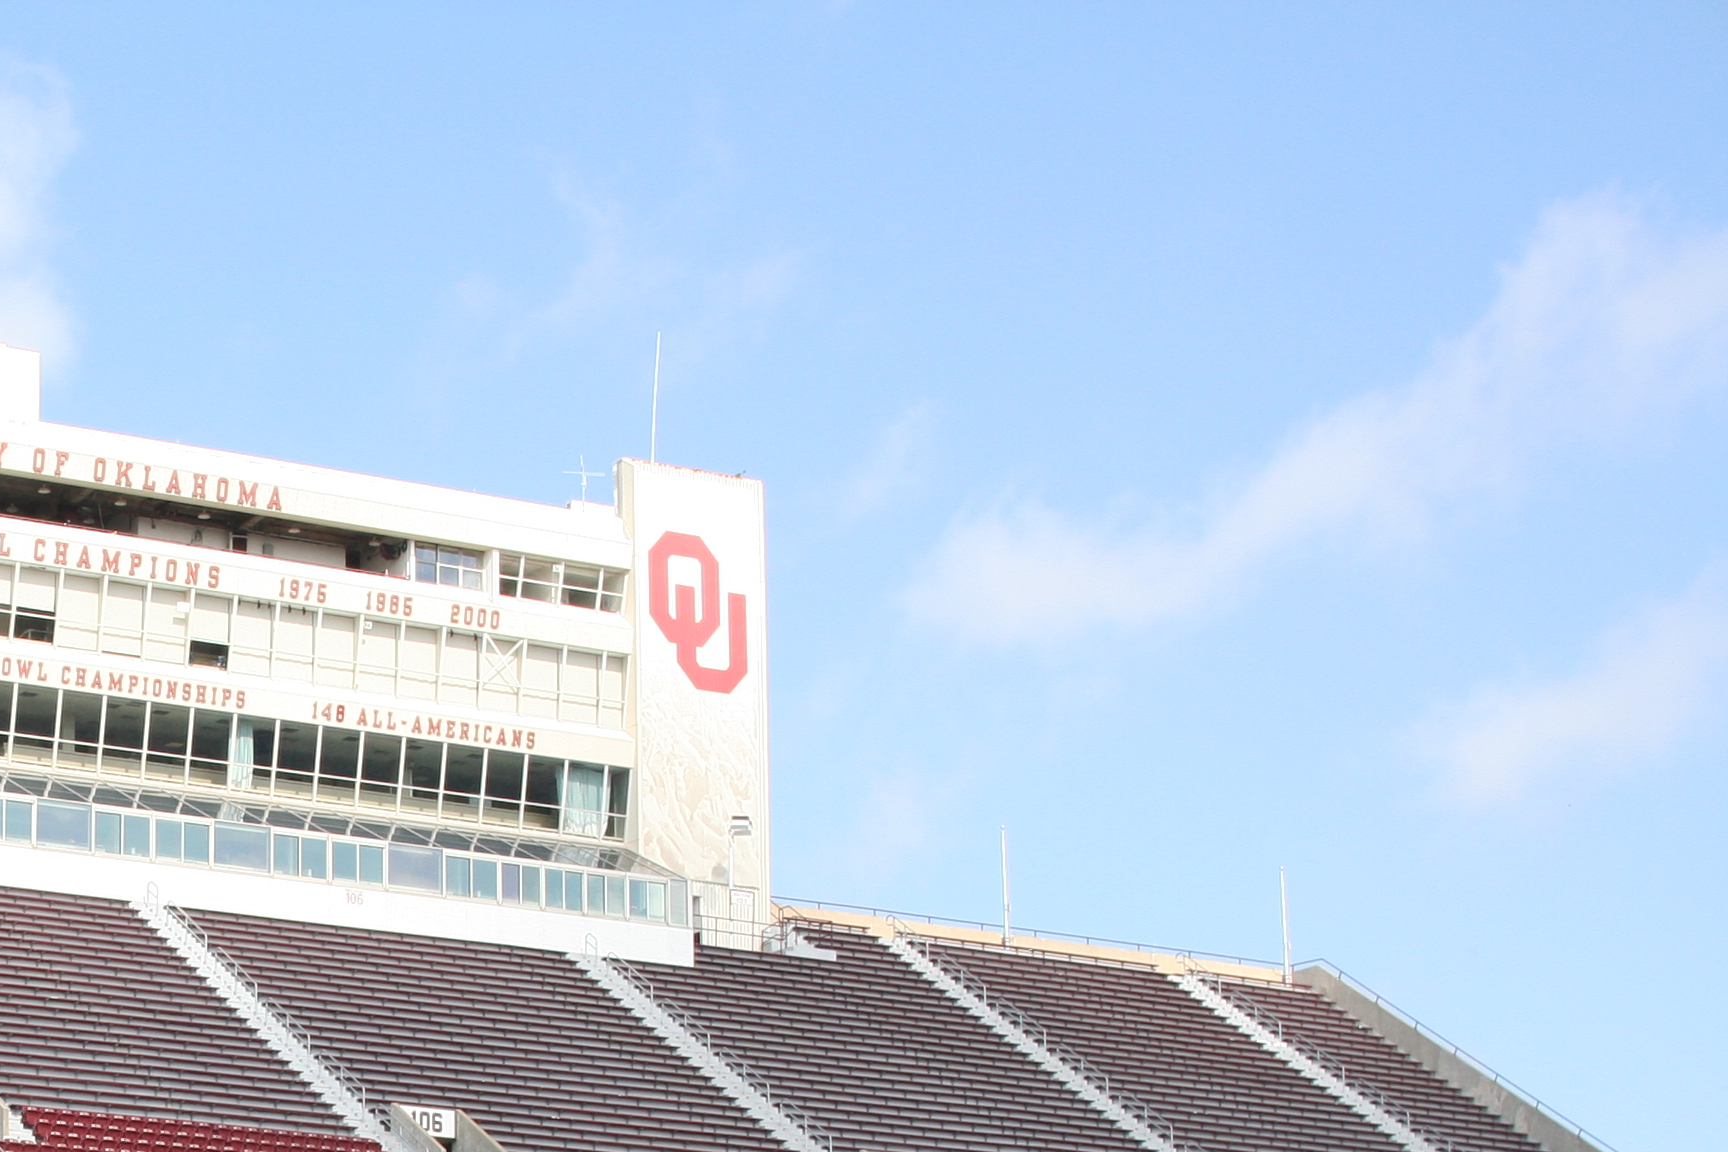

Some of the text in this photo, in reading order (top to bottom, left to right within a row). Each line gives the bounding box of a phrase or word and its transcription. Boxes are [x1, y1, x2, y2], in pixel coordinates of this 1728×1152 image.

[33, 447, 70, 477] OF
[93, 458, 283, 511] OKLAHOMA
[33, 539, 221, 588] CHAMPIONS
[278, 577, 327, 603] 1975
[365, 591, 413, 617] 1985
[450, 605, 501, 630] 2000
[61, 664, 247, 709] CHAMPIONSHIPS
[311, 702, 536, 750] 148 ALL-AMERICANS
[345, 892, 363, 905] 106
